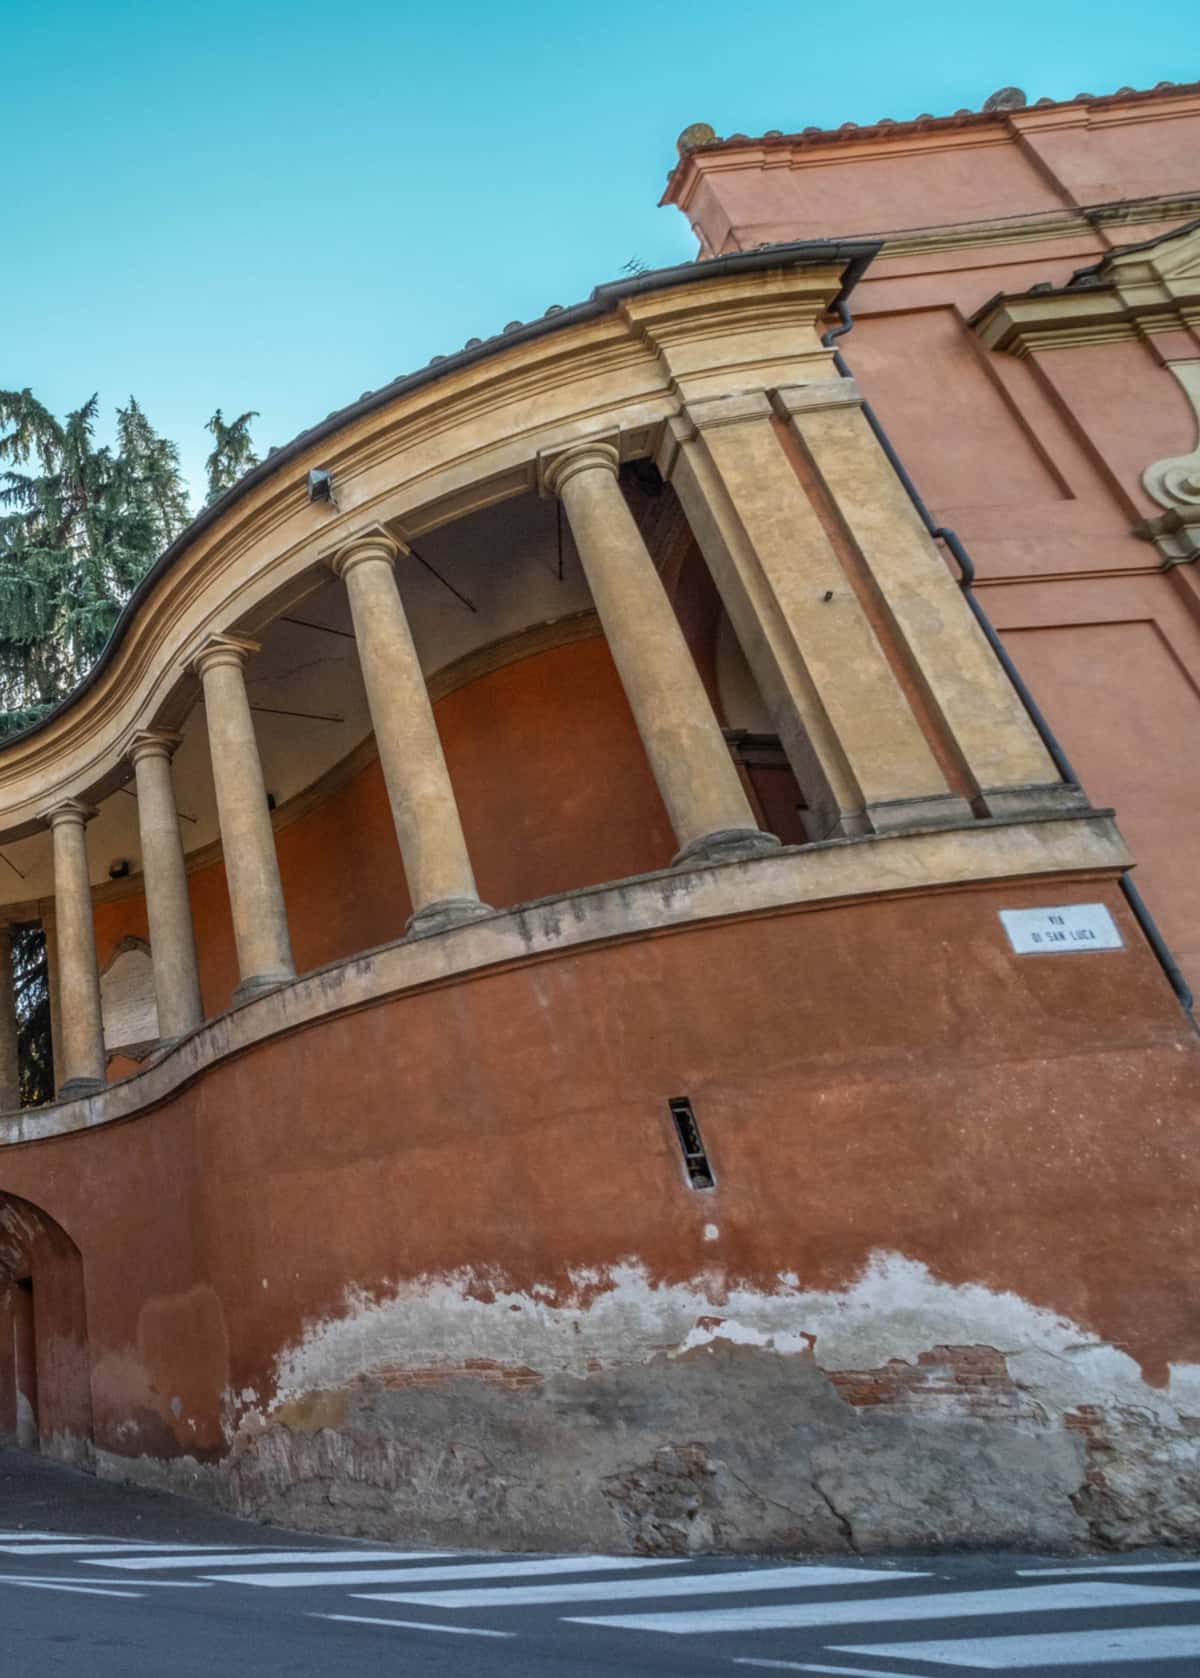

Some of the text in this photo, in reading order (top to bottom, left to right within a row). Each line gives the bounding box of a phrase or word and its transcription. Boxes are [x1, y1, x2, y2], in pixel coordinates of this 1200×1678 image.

[1048, 915, 1065, 925] VIA
[1032, 929, 1096, 943] DI SAN LUCA
